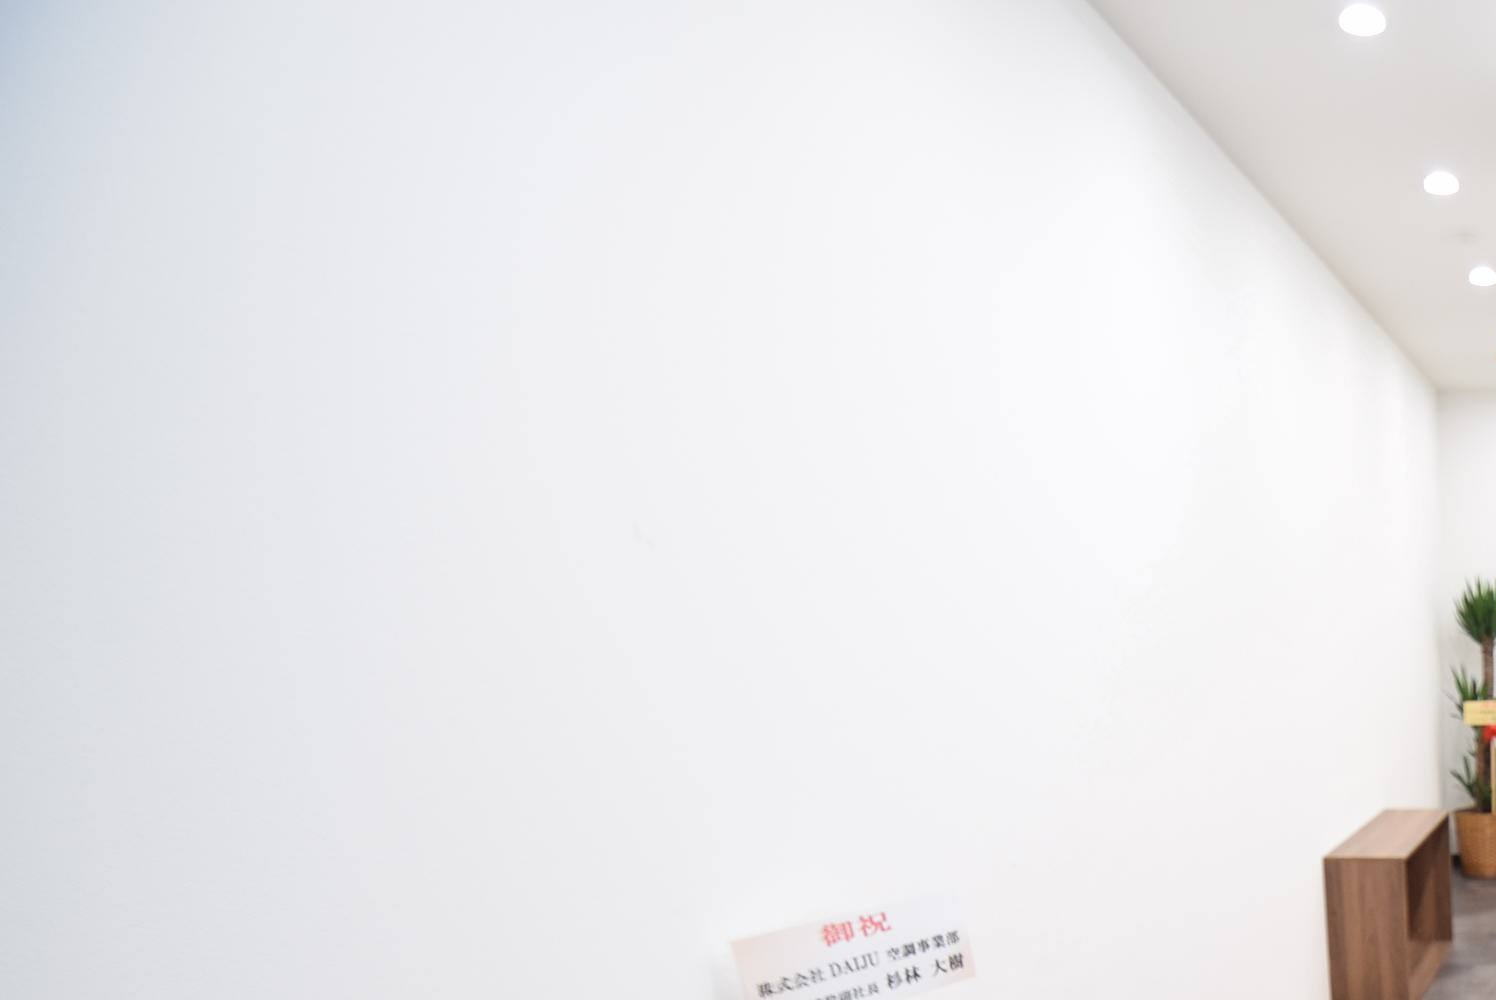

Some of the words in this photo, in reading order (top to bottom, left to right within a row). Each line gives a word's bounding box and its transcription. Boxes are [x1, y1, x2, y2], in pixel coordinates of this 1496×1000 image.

[821, 911, 892, 947] 御祝
[756, 969, 825, 998] 株式会社
[886, 930, 961, 961] 空調事業部
